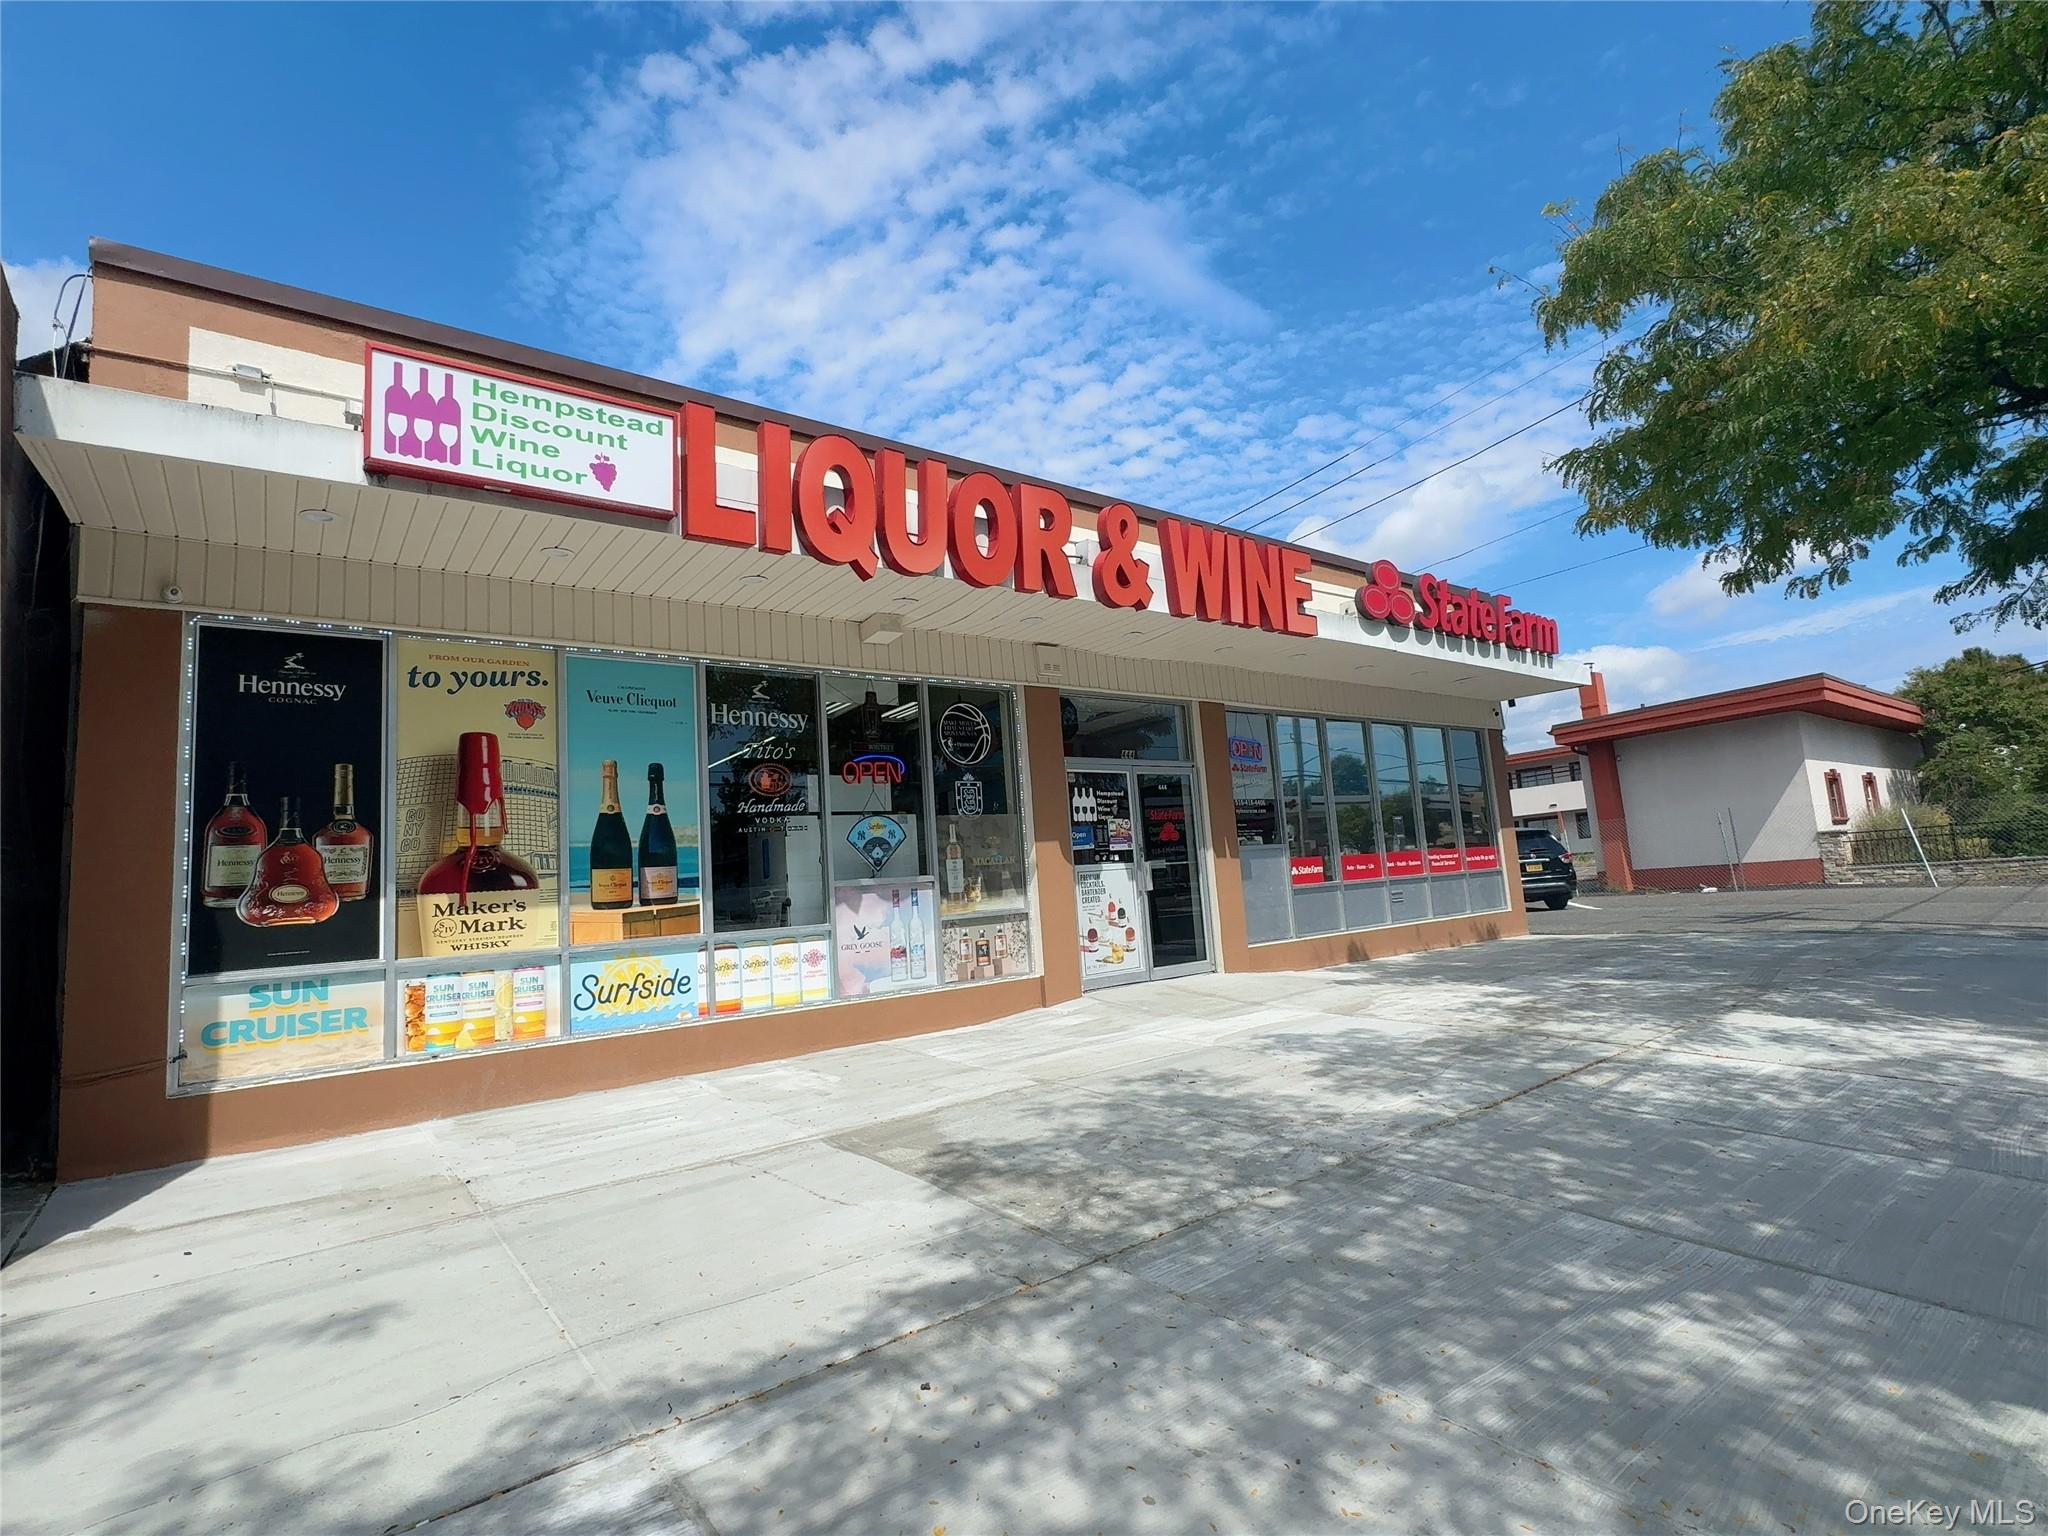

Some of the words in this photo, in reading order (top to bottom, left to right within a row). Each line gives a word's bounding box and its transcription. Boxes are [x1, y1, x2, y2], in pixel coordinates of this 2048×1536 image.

[473, 379, 663, 436] Hempstead
[472, 403, 628, 450] Discount
[470, 425, 561, 458] Wine
[472, 449, 588, 486] Liquor
[681, 400, 1077, 599] LIQUOR
[1093, 503, 1153, 610] &
[1158, 517, 1318, 638] WINE
[428, 654, 459, 662] FROM
[462, 657, 486, 665] OUR
[487, 659, 530, 667] GARDEN
[238, 674, 346, 701] Hennessy
[407, 665, 441, 688] to
[446, 669, 549, 695] yours.
[268, 697, 318, 705] COGNAC
[586, 689, 623, 704] Veuve
[626, 692, 676, 709] Clicquot
[711, 703, 808, 733] Hennessy
[743, 742, 796, 760] Tito's
[843, 761, 902, 785] OPEN
[737, 797, 806, 813] Handmade
[403, 823, 424, 837] NY
[432, 899, 526, 918] Maker's
[458, 917, 525, 935] Mark
[450, 940, 512, 952] WHISKY
[841, 943, 858, 951] GREY
[743, 959, 769, 970] Surfside
[433, 983, 455, 992] SUN
[468, 981, 489, 991] SUN
[514, 984, 544, 993] CRUISER
[520, 976, 539, 985] SUN
[249, 978, 329, 1010] SUN
[427, 992, 461, 1003] CRUISER
[462, 989, 495, 1000] CRUISER
[574, 968, 692, 1012] Surfside
[202, 1006, 367, 1050] CRUISER
